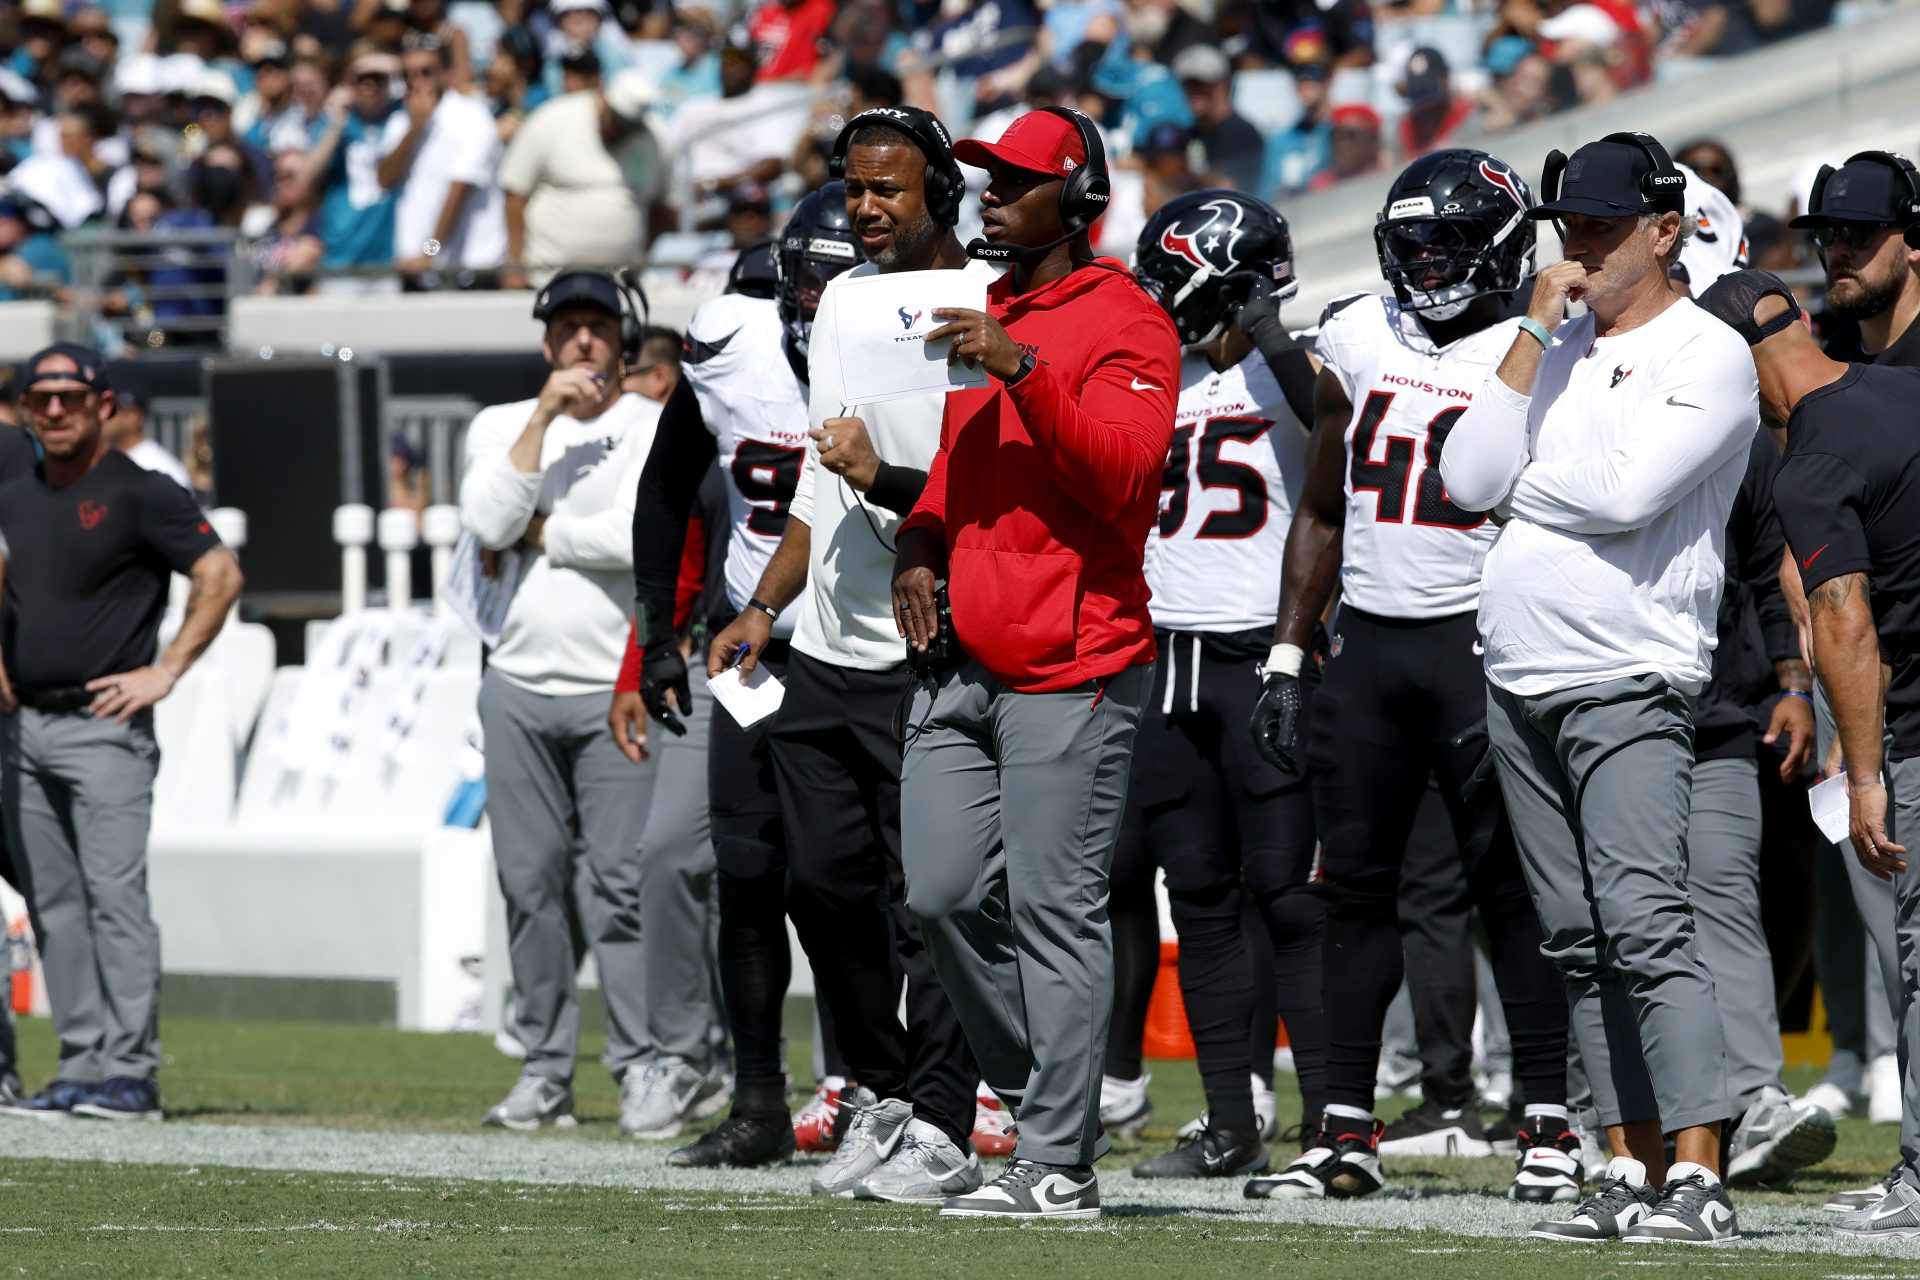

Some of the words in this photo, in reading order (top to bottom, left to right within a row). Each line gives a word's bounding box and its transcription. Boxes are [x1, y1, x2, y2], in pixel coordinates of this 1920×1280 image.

[851, 108, 910, 121] ONY
[931, 120, 951, 149] SONY
[1654, 176, 1684, 185] SONY
[1085, 192, 1110, 203] SONY
[1393, 202, 1424, 211] TEXANS
[977, 248, 1010, 257] SONY
[1382, 373, 1473, 402] HOUSTON
[770, 430, 810, 442] HOU
